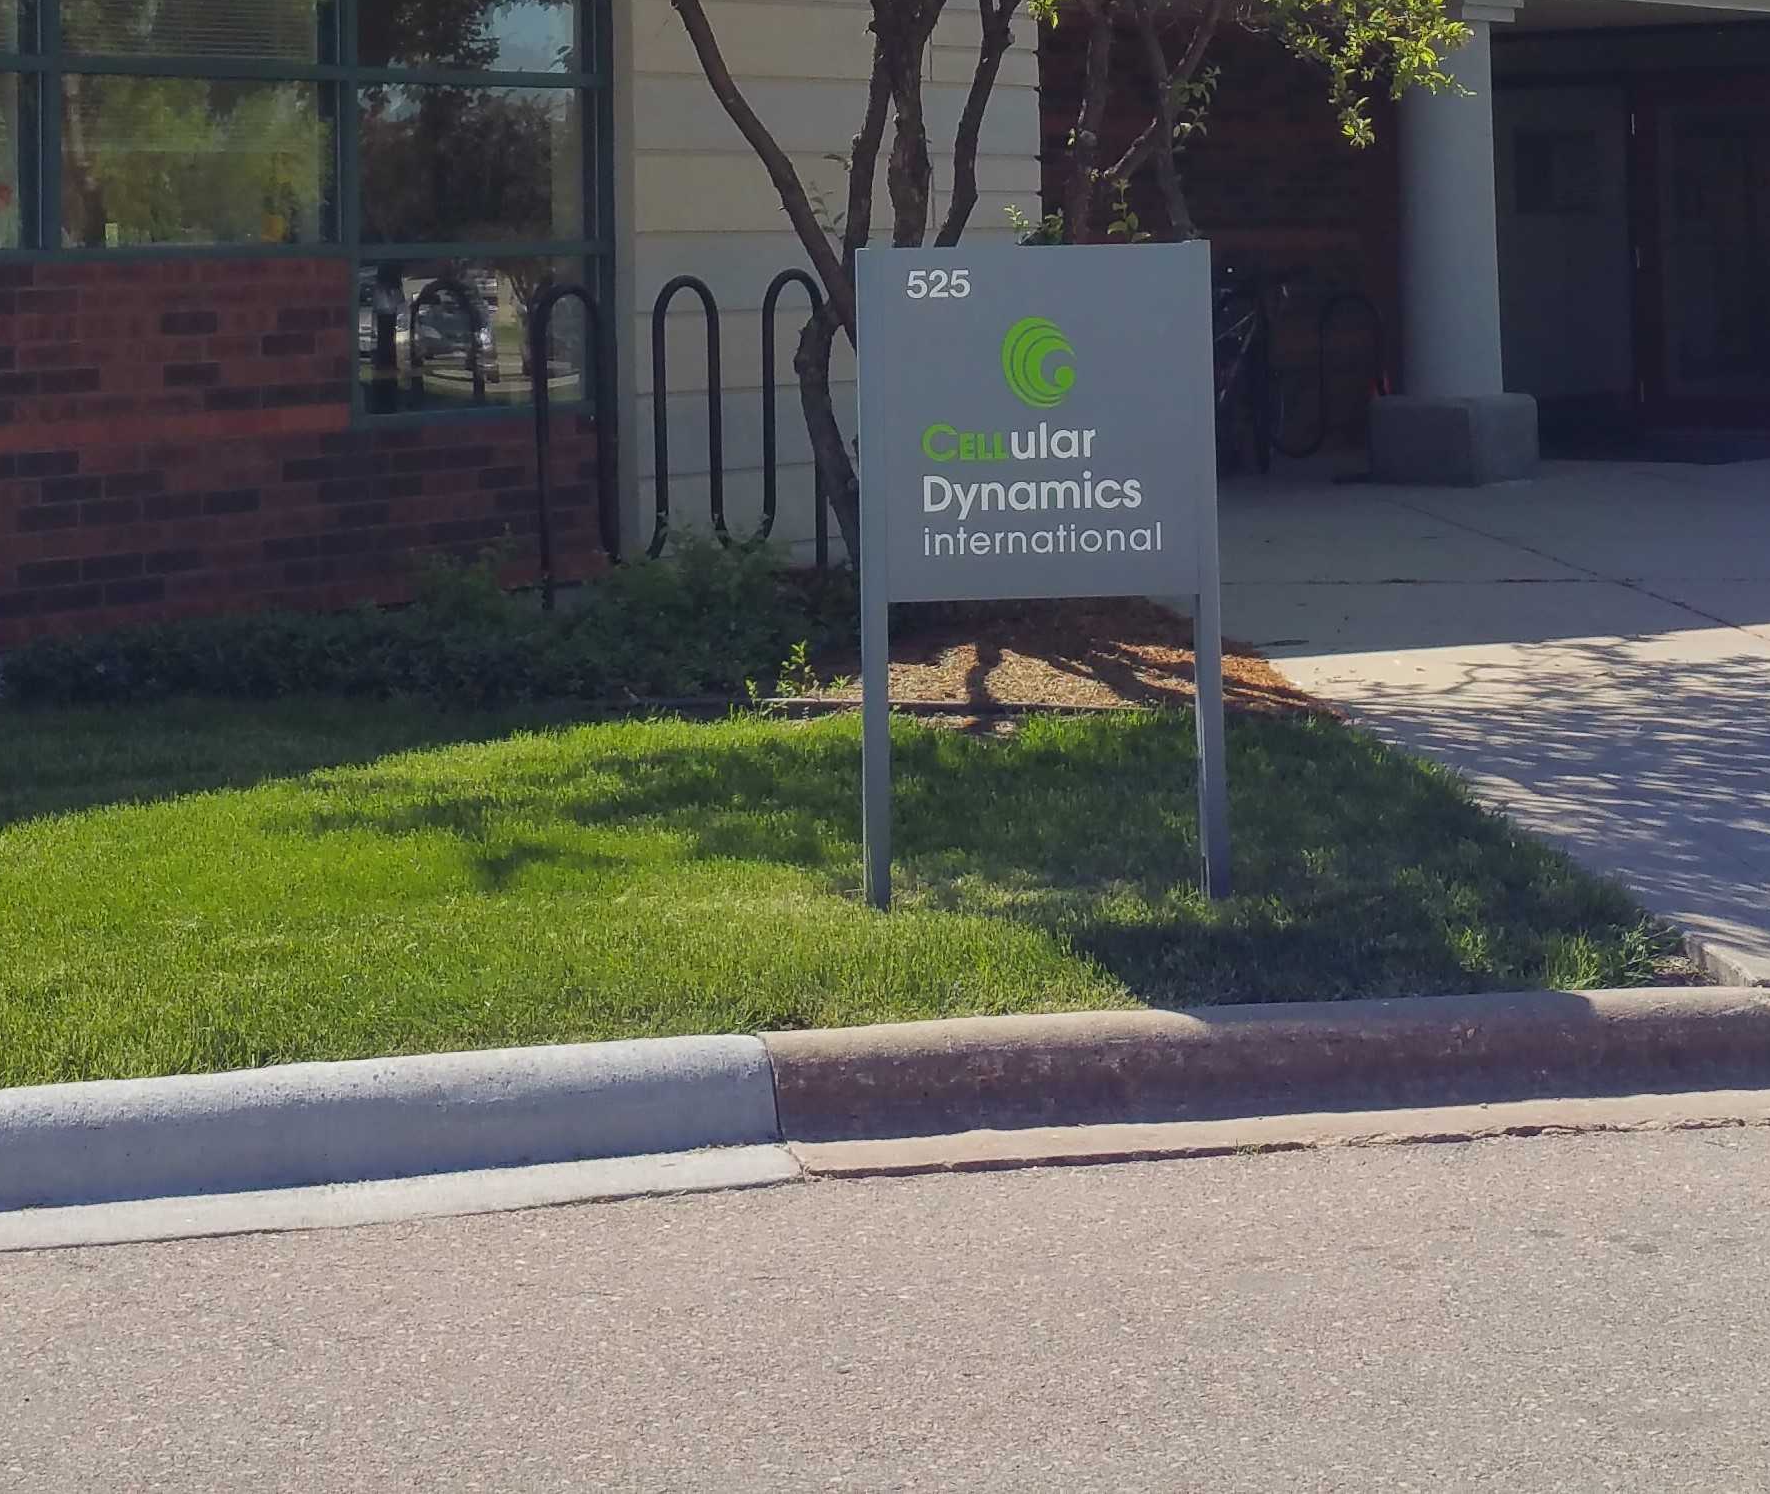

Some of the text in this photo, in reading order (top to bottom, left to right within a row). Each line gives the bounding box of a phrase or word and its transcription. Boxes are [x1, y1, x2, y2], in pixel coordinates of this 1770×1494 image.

[905, 269, 971, 299] 525
[922, 470, 1142, 520] Dynamics
[924, 522, 1163, 556] international
